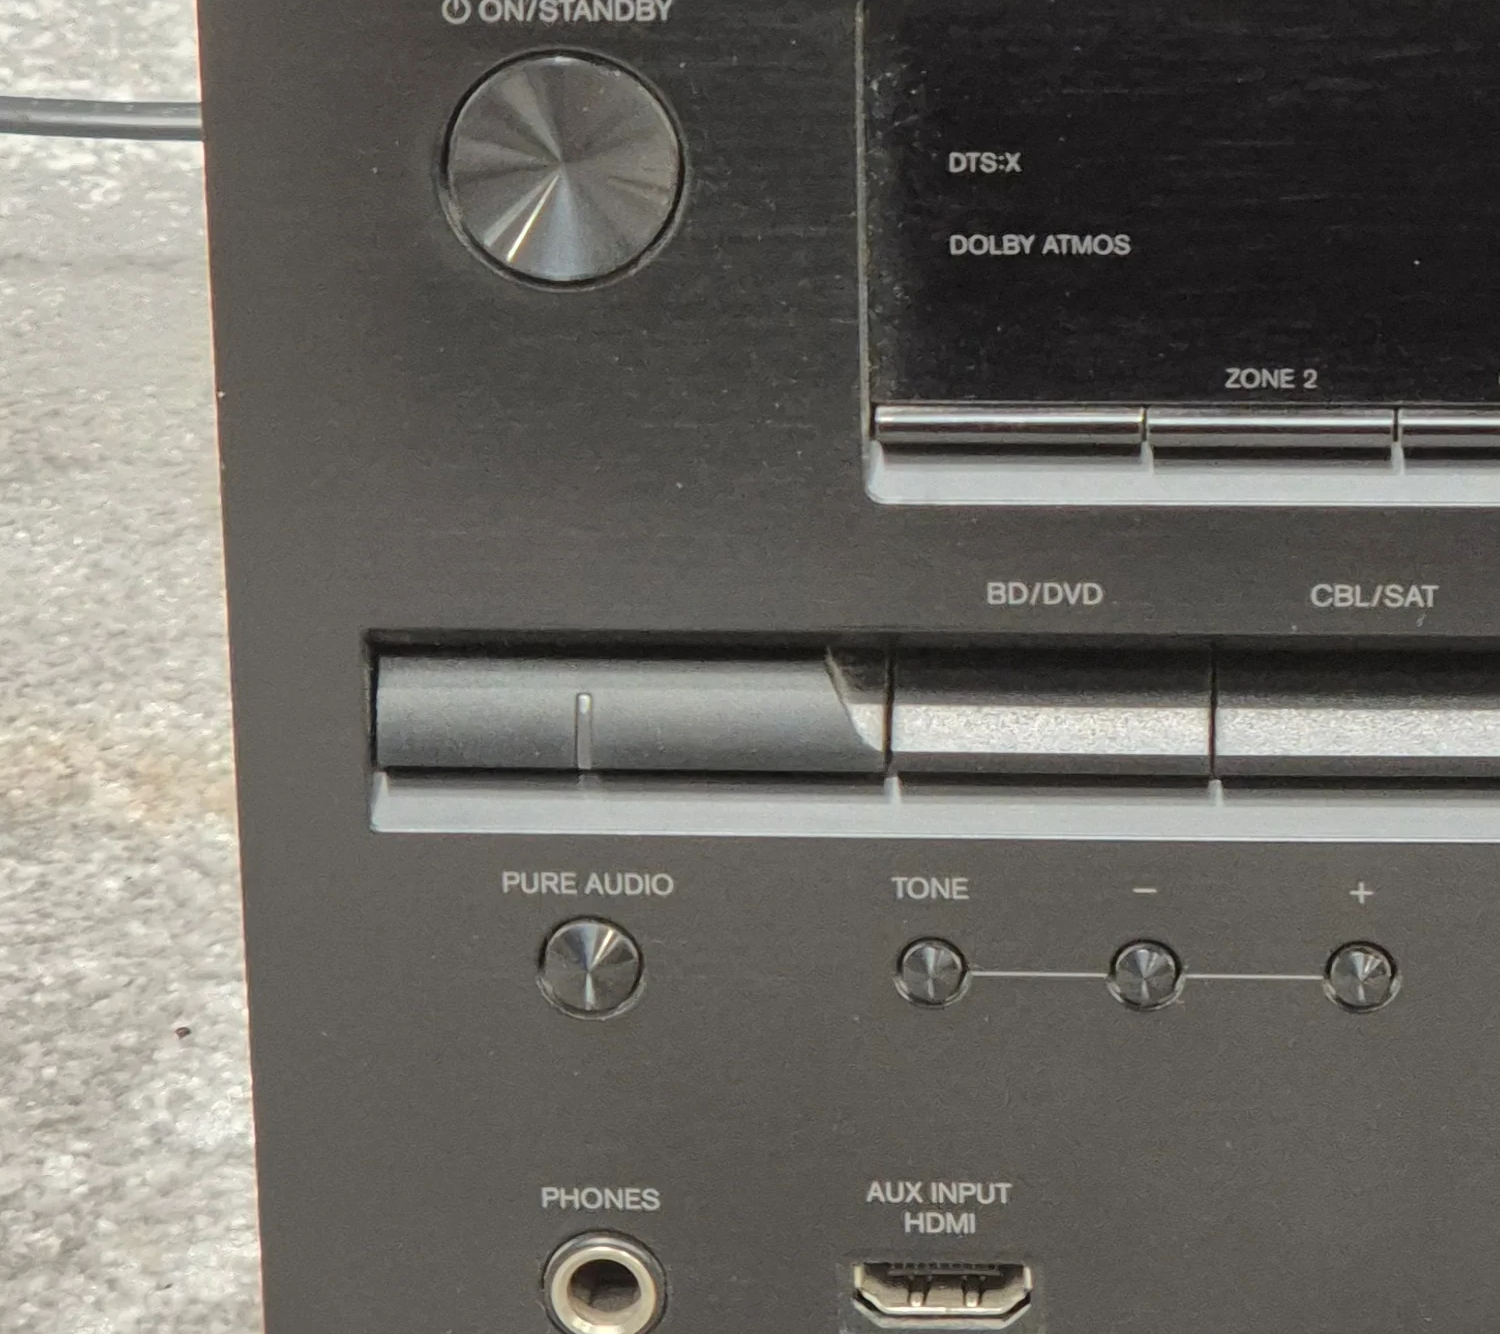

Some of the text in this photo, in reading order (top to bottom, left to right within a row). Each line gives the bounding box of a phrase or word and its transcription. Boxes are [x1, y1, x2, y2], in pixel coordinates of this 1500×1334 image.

[948, 151, 1022, 174] DTS:X
[949, 233, 1132, 256] DOLBY ATMOS
[1224, 367, 1318, 389] ZONE 2
[986, 581, 1104, 606] BD/DVD
[1310, 583, 1439, 609] CBL/SAT
[502, 871, 675, 897] PURE AUDIO
[891, 876, 970, 900] TONE
[541, 1186, 661, 1211] PHONES
[866, 1180, 1013, 1205] AUX INPUT
[904, 1211, 976, 1234] HDMI
